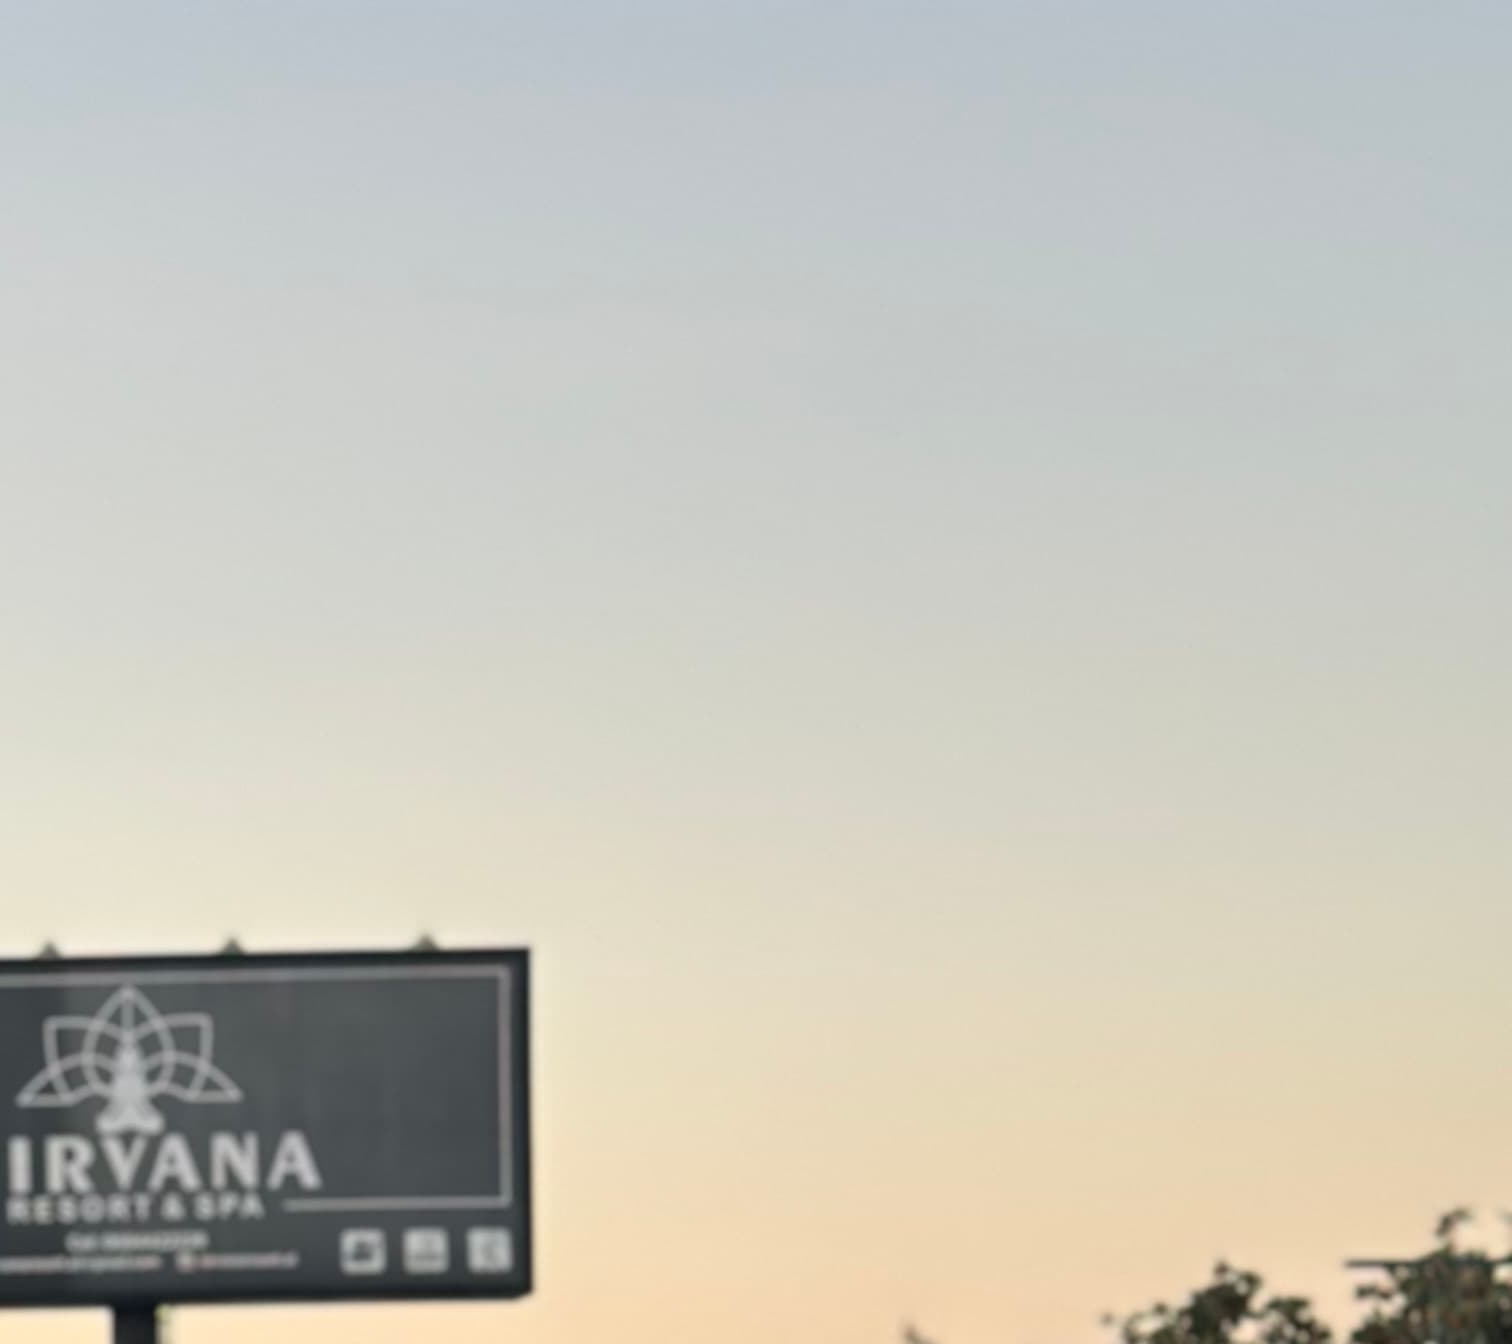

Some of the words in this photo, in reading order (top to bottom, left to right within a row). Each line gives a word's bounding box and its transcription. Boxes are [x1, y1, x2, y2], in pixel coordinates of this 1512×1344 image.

[6, 1193, 150, 1225] RESORT
[160, 1191, 185, 1222] &
[194, 1190, 266, 1221] SPA
